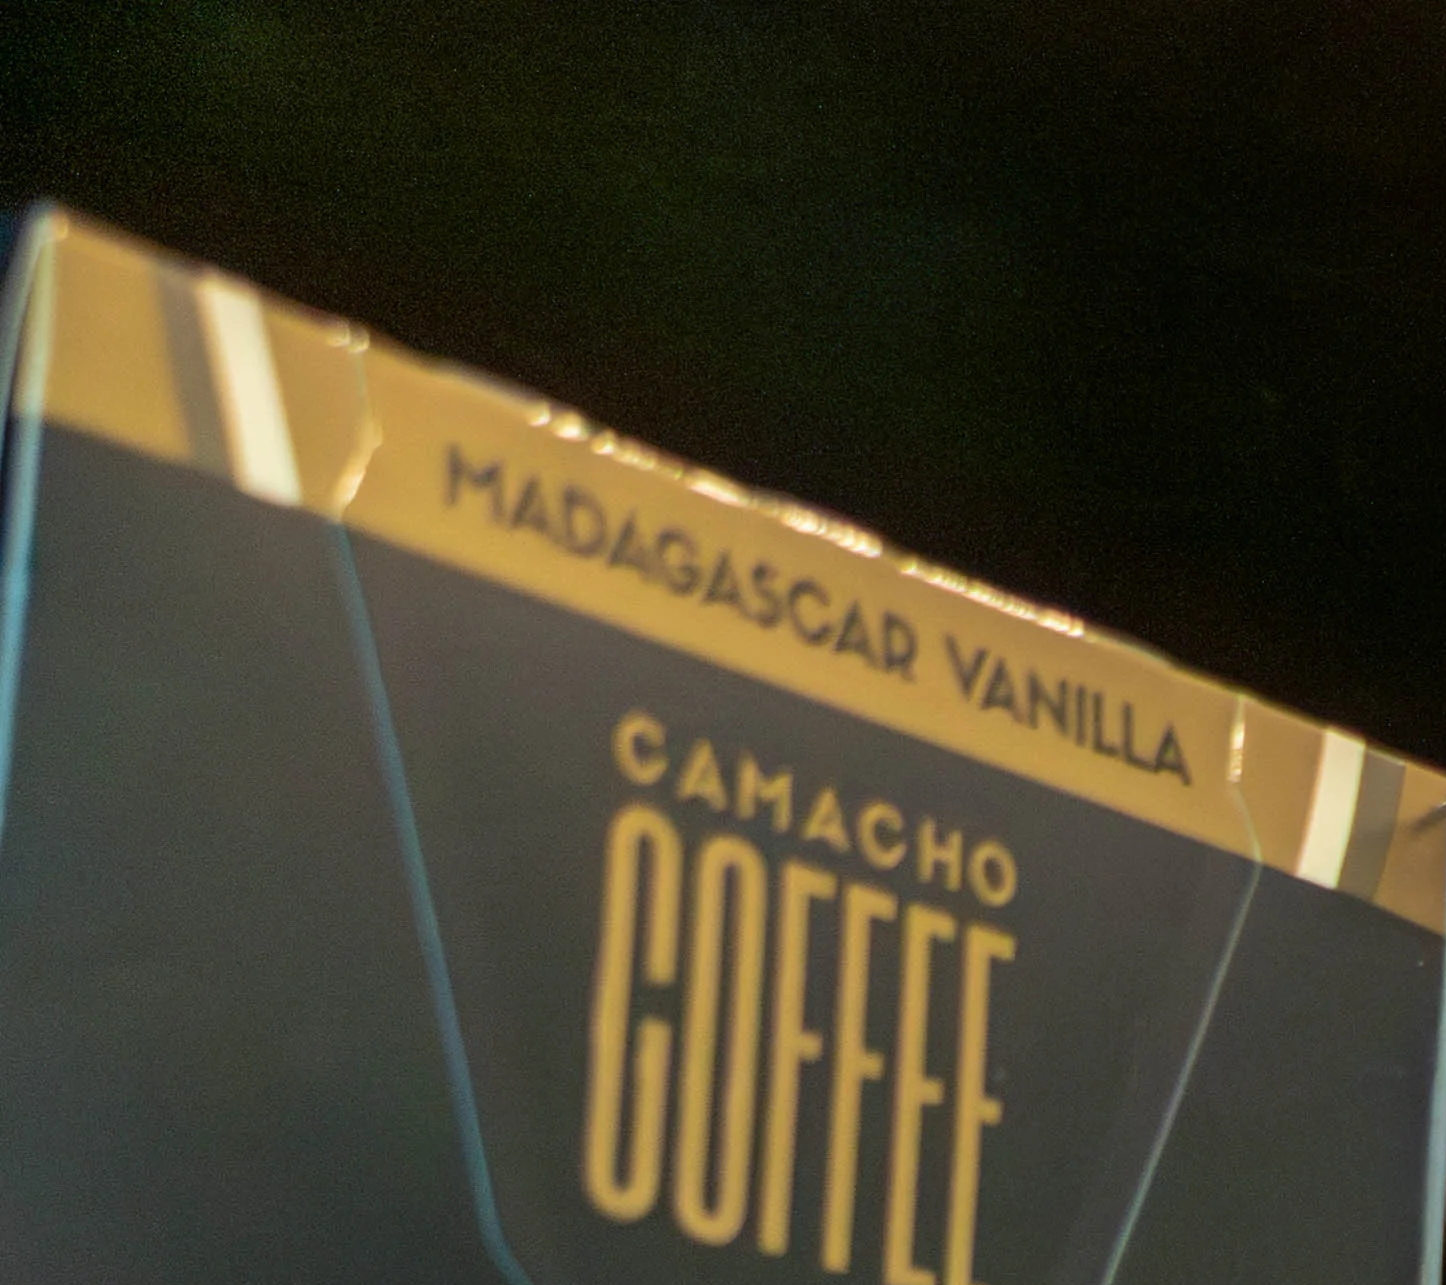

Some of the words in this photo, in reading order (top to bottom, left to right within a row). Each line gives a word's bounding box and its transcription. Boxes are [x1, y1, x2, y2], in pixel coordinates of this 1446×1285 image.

[443, 444, 918, 684] MADAGASCAR
[945, 631, 1193, 789] VANILLA
[613, 711, 1017, 906] CAMACHO
